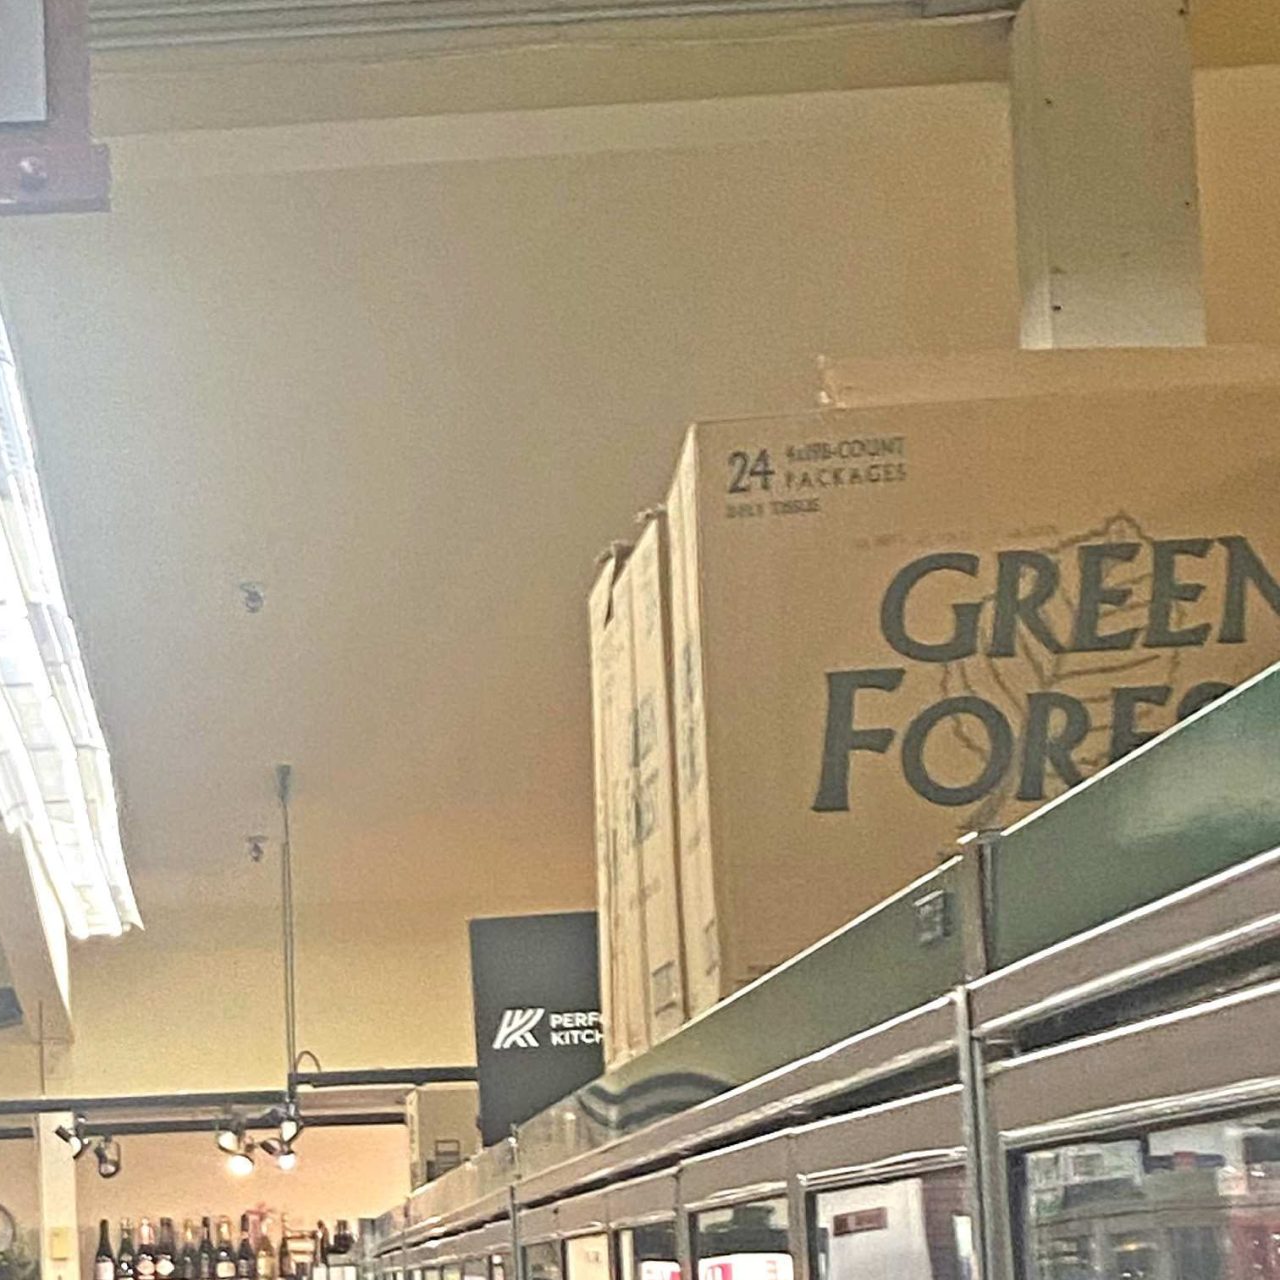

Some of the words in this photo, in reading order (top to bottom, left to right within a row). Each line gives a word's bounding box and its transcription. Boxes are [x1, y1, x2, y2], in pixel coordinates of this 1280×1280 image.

[728, 449, 776, 494] 24
[785, 463, 908, 490] PACKAGES
[880, 535, 1280, 663] GREEN
[550, 1011, 603, 1029] PERF
